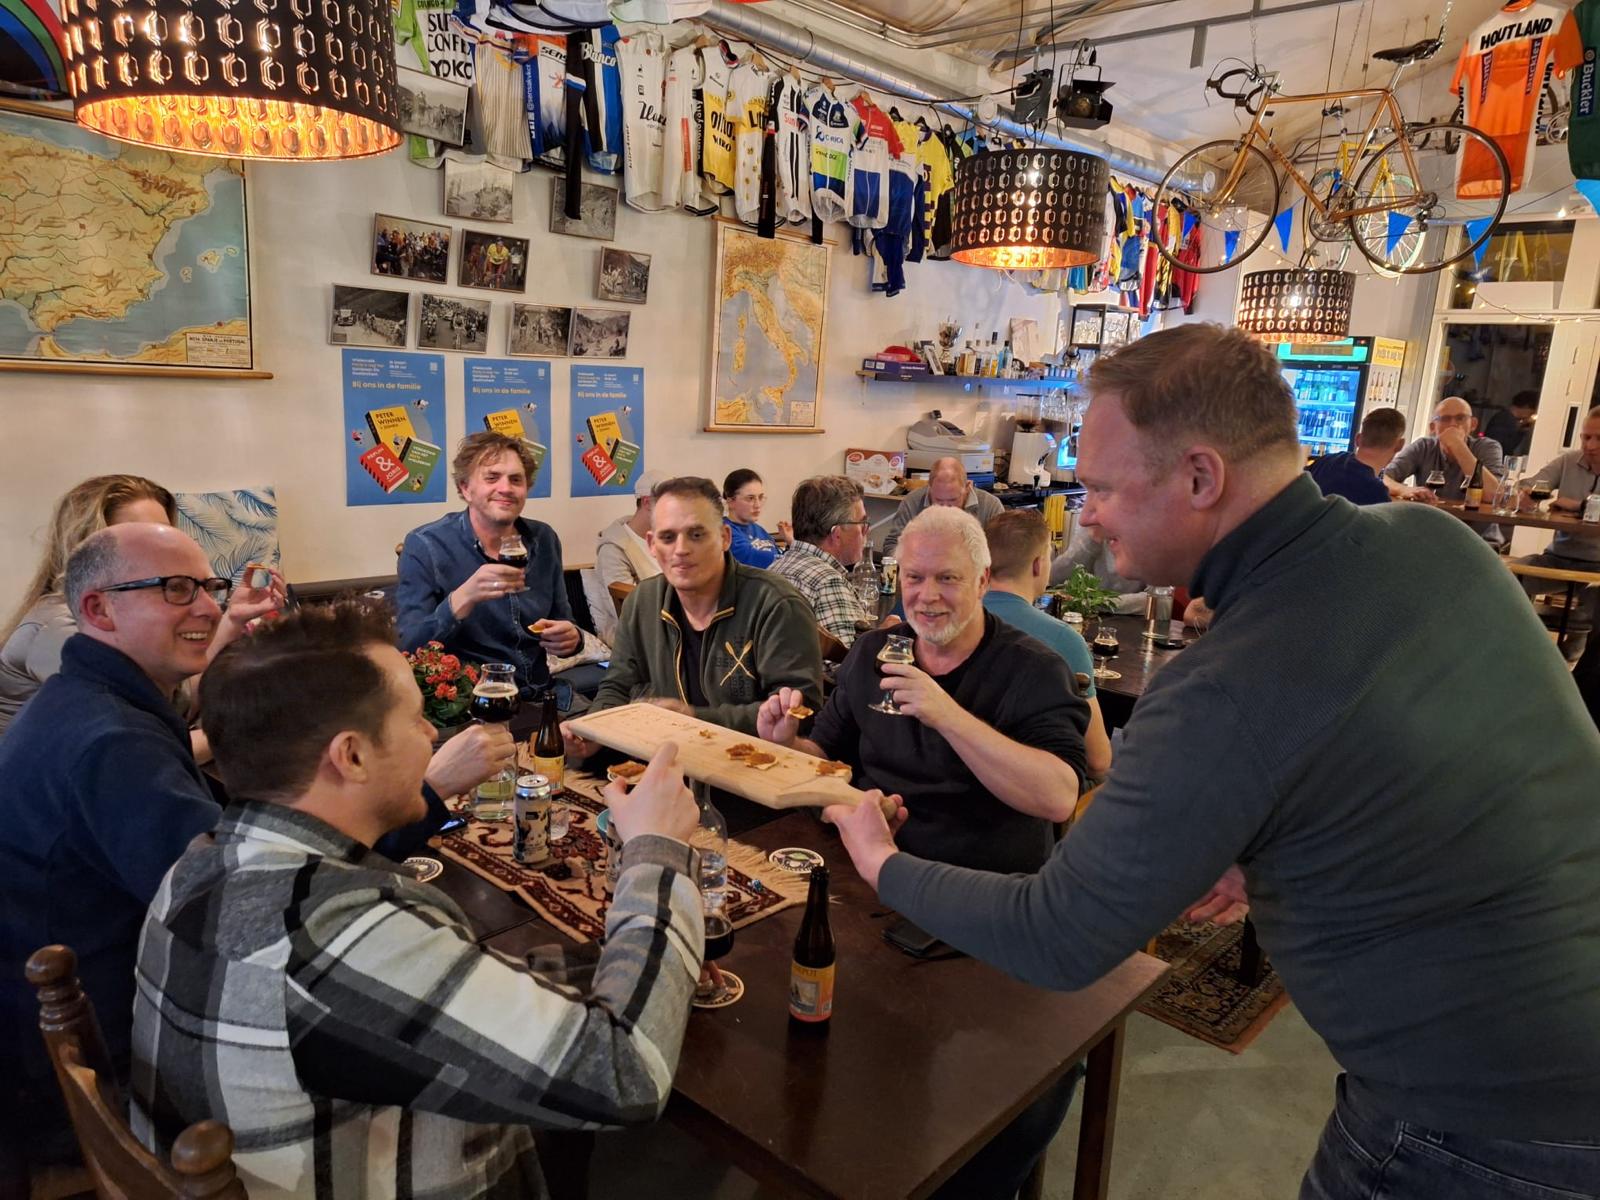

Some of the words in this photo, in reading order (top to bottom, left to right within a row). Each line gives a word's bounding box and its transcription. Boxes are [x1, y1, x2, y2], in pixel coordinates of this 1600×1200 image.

[1480, 18, 1553, 51] HOUTLAND
[580, 42, 617, 66] Blanco
[430, 60, 472, 79] YOKO
[1579, 63, 1594, 114] Buckler
[377, 381, 384, 389] in
[397, 381, 421, 390] familie
[375, 411, 393, 419] PETER
[377, 416, 406, 425] WINNEN
[494, 419, 518, 427] WINNEN
[375, 456, 395, 472] &
